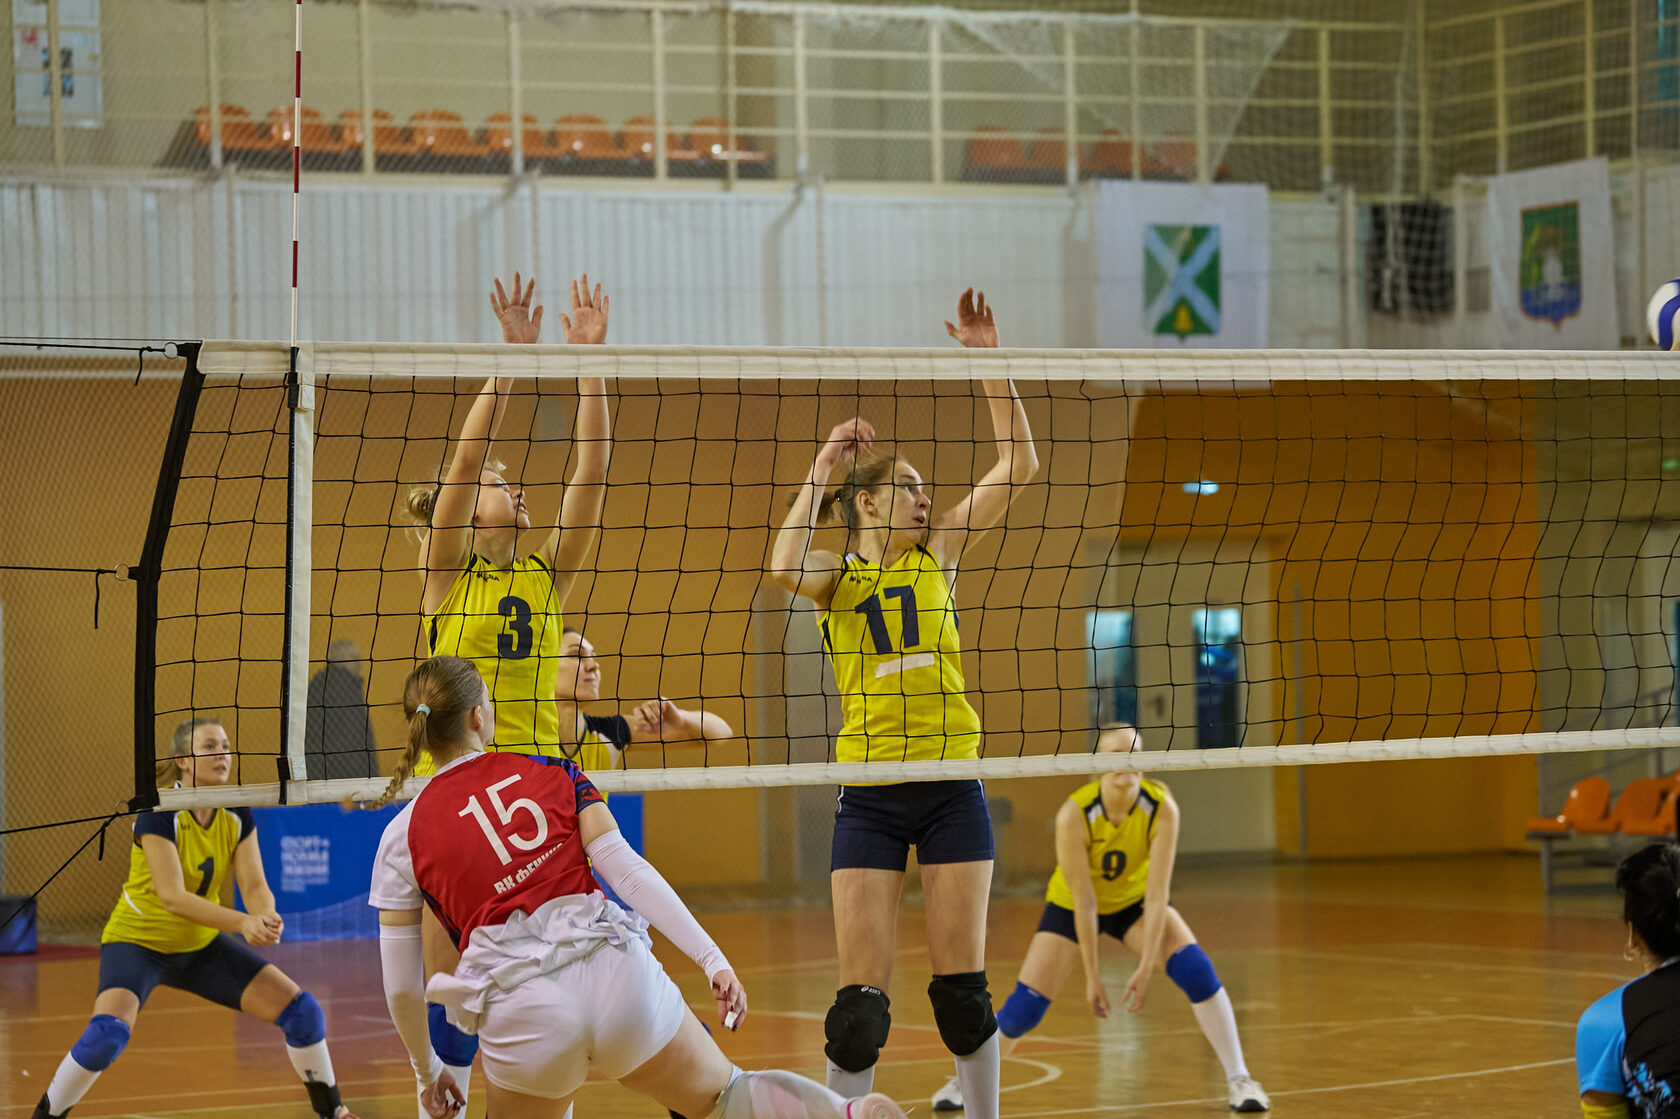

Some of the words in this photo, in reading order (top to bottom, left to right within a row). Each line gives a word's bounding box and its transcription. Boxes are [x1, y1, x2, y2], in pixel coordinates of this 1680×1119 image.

[497, 596, 533, 660] 3
[855, 585, 920, 656] 17
[458, 773, 548, 866] 15
[196, 856, 215, 896] 1
[1101, 850, 1127, 881] 9
